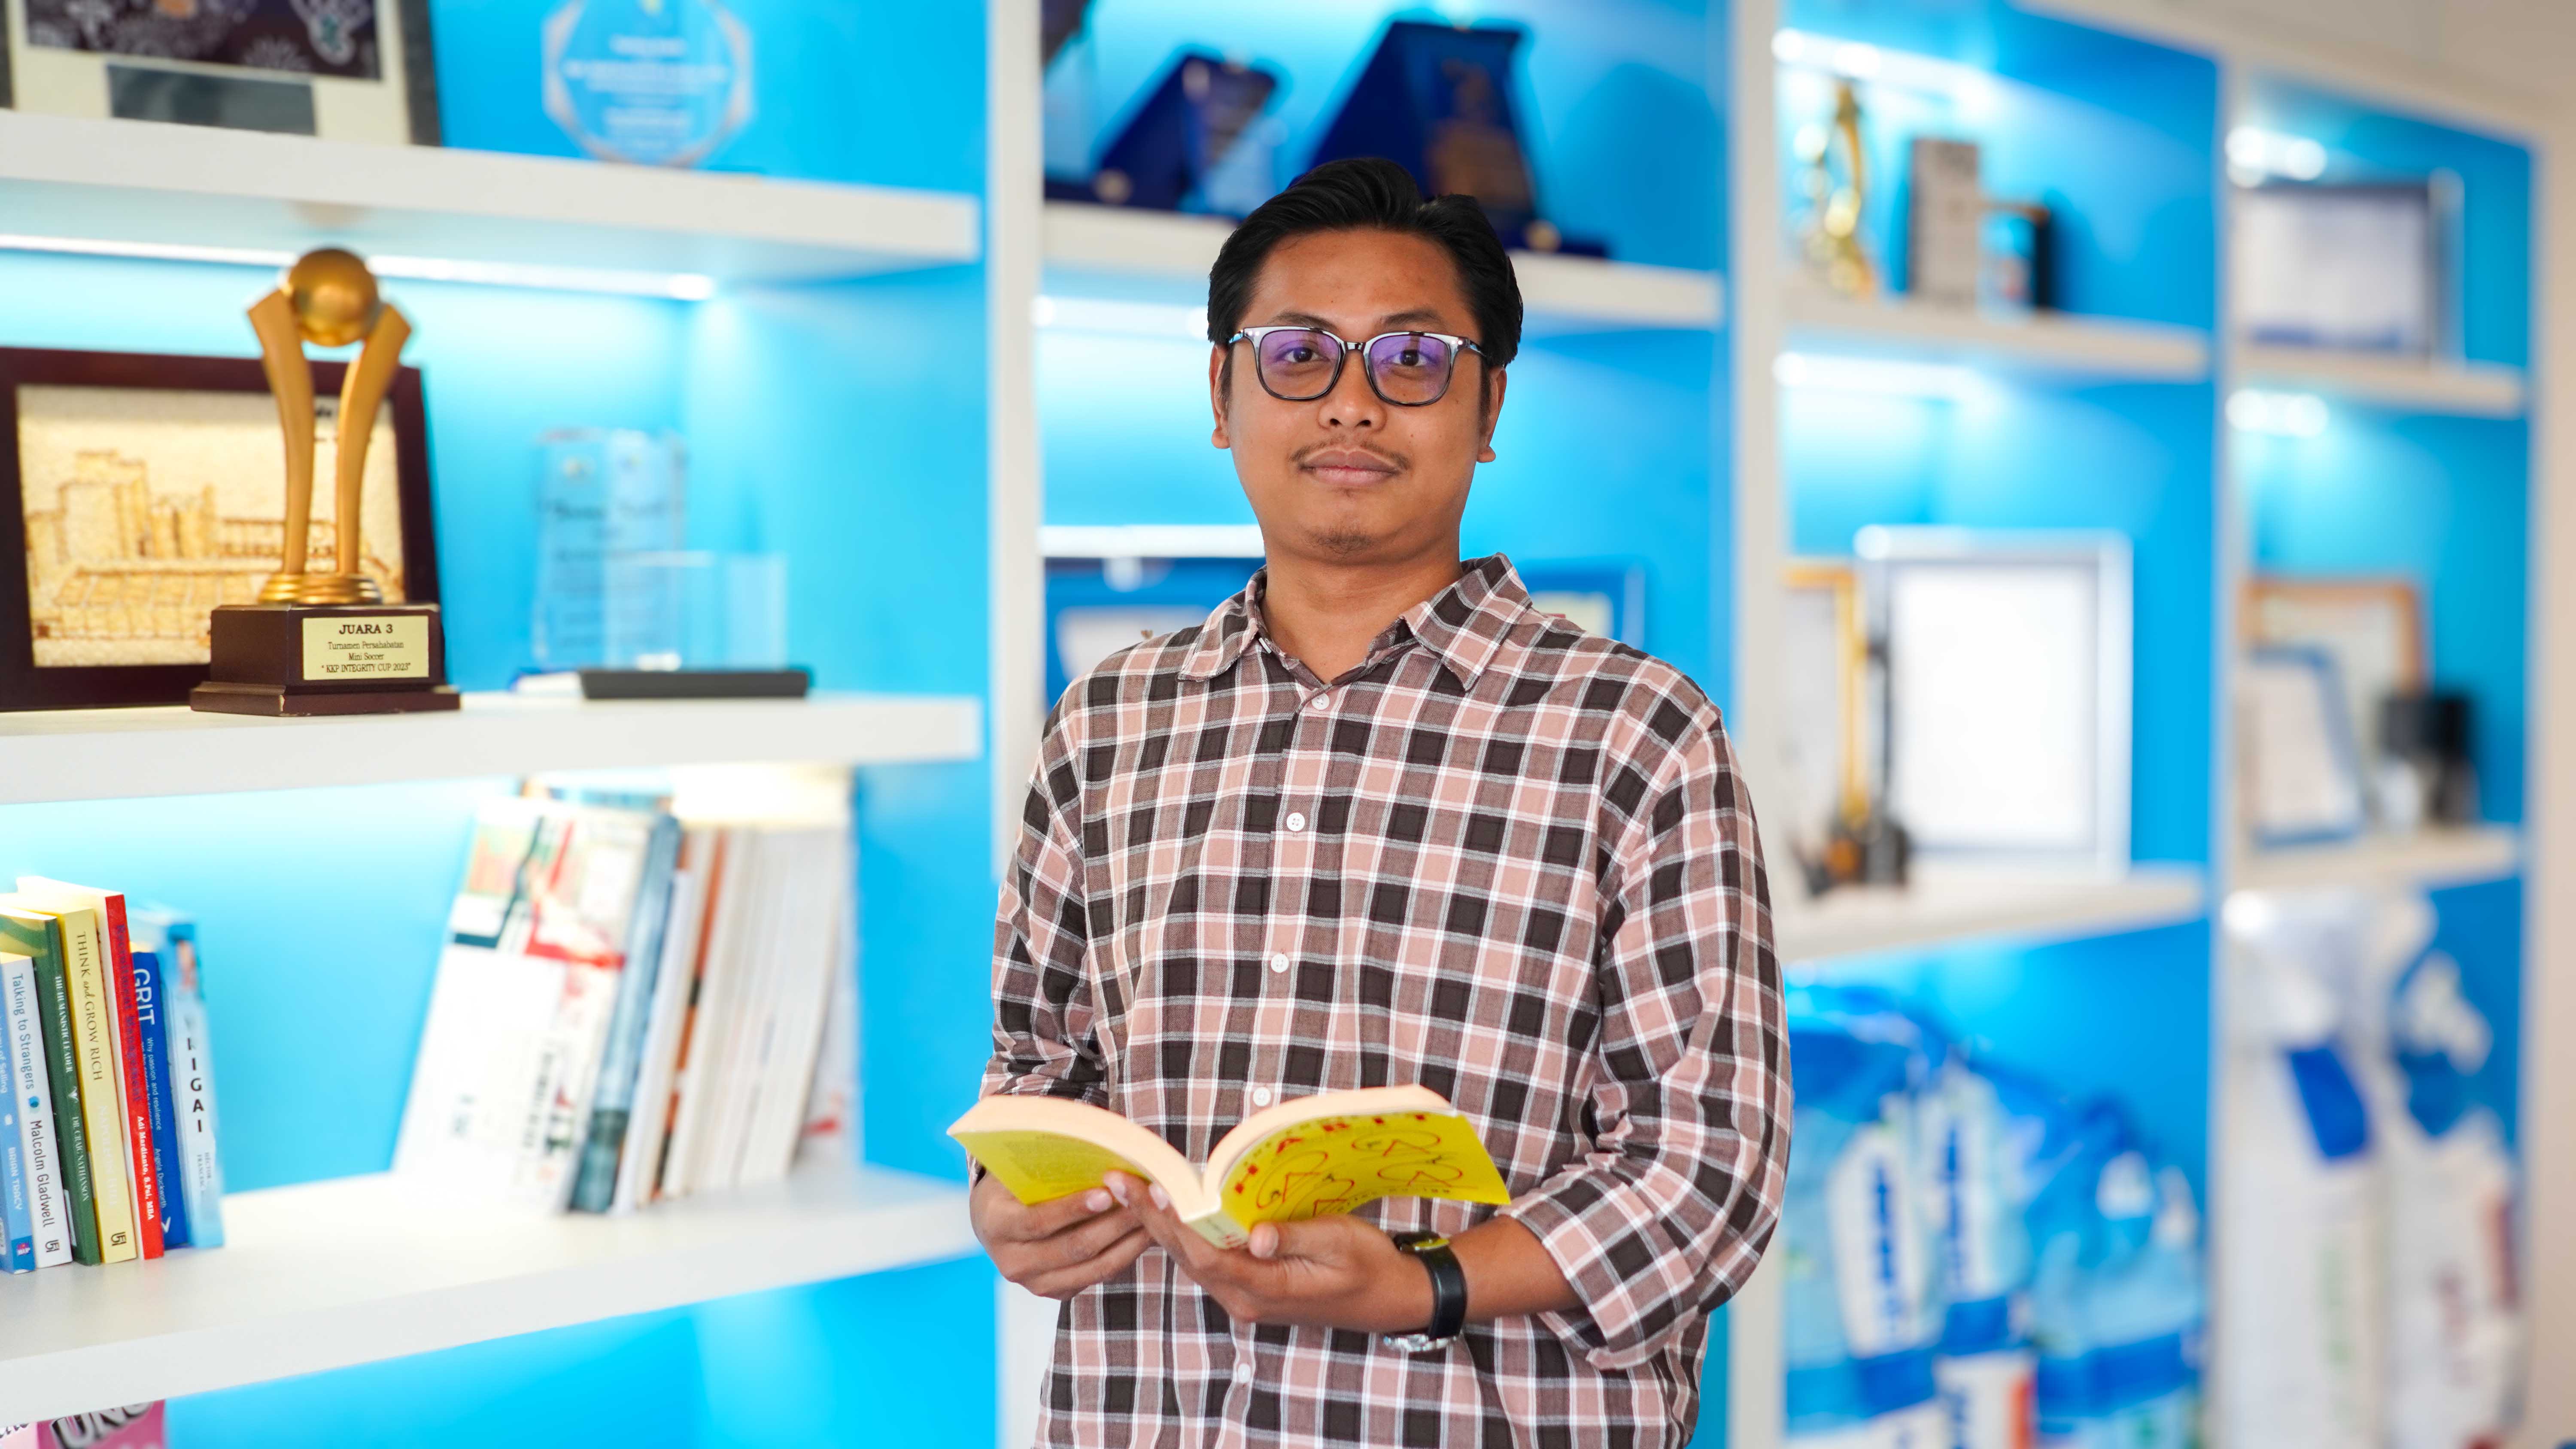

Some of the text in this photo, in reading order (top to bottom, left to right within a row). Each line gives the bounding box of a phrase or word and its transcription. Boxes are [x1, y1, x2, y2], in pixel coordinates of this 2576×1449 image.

[339, 624, 393, 634] JUARA 3
[341, 664, 375, 673] INTEGRITY
[378, 663, 391, 671] CUP
[77, 931, 103, 1080] THINK and GROW RICH
[116, 925, 142, 1101] Recruitment Management
[133, 968, 155, 1025] GRIT
[12, 973, 34, 1090] Talking to Strangers
[149, 1054, 157, 1081] passion
[30, 1120, 46, 1170] Malcolm
[8, 1147, 23, 1210] BRIAN TRACY
[37, 1174, 55, 1227] Gladwell
[146, 1201, 155, 1220] MBA
